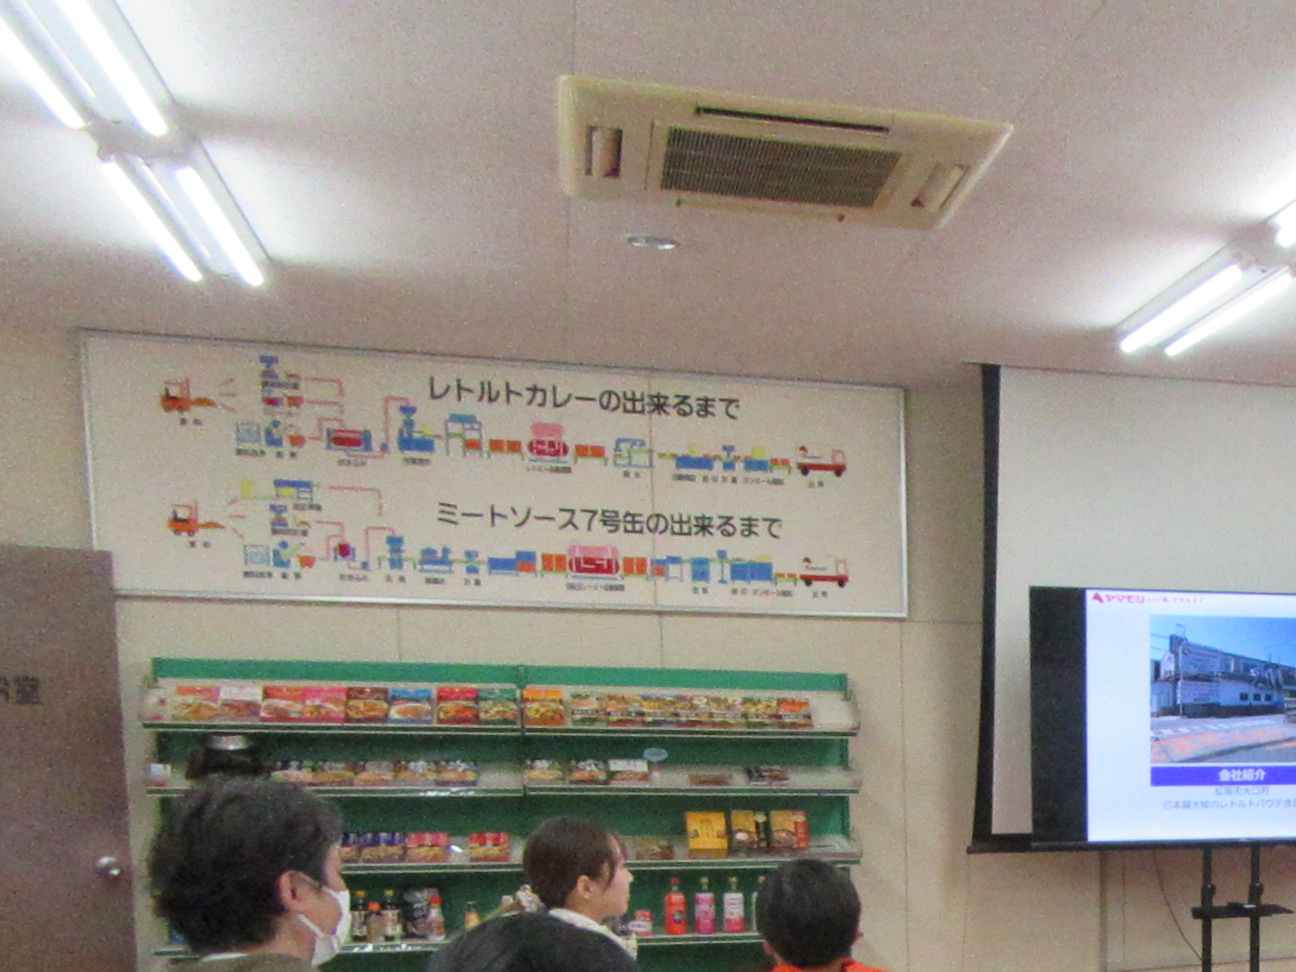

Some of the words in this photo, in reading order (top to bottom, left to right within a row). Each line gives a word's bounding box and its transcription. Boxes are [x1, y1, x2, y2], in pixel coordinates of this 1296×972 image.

[429, 375, 740, 420] レトルトカレーの出来るまで
[436, 501, 783, 540] ミートソース7号缶の出来るまで
[1218, 768, 1266, 782] 会社紹介
